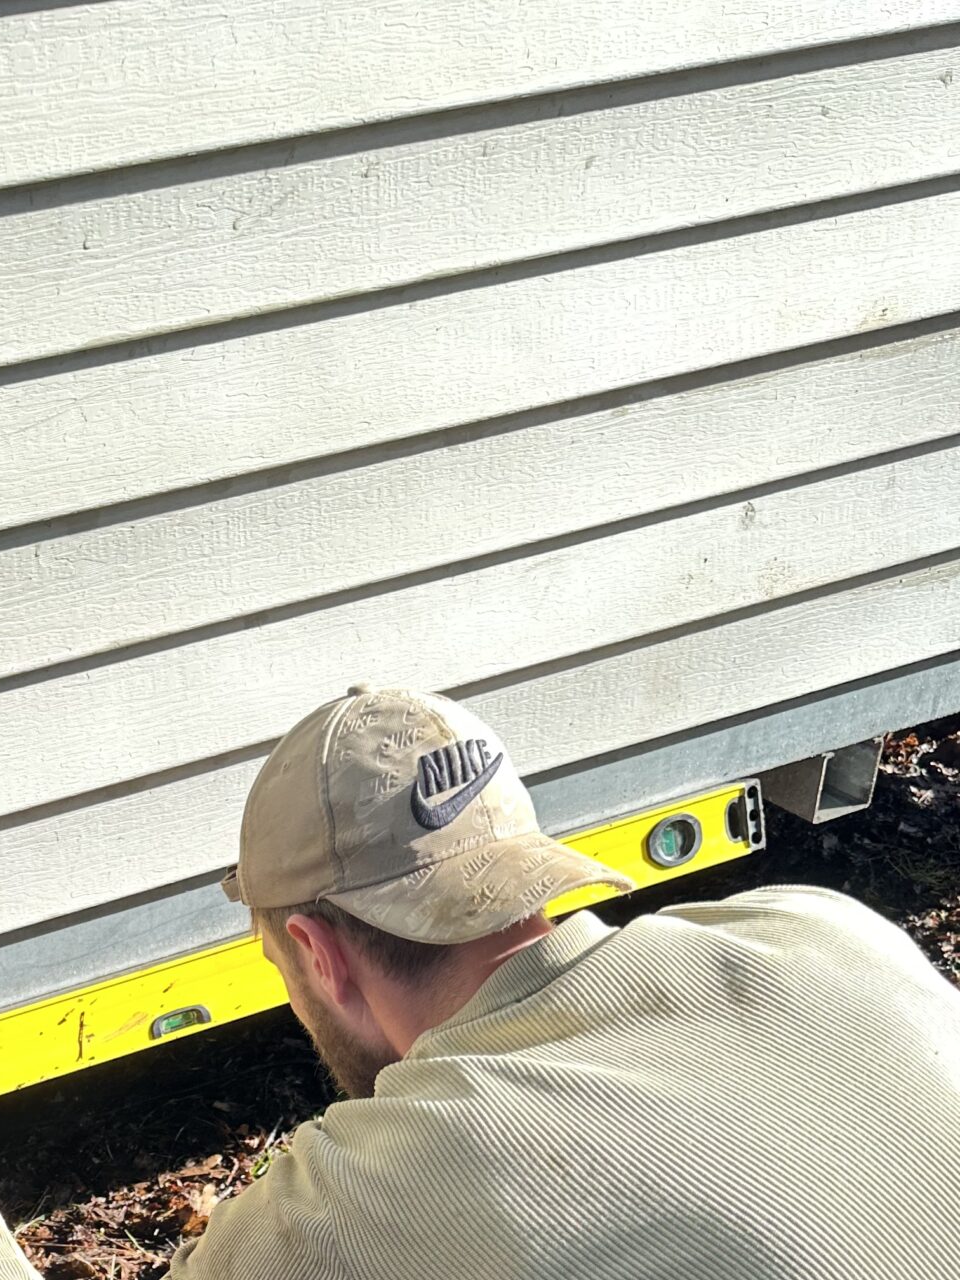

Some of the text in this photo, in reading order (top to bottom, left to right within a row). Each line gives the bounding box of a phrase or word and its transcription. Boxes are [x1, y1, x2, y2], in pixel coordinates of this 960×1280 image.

[381, 727, 425, 750] NIKE
[417, 738, 492, 800] NIKE
[460, 850, 495, 880] NIKE
[520, 852, 553, 874] NIKE
[519, 875, 556, 907] NIKE
